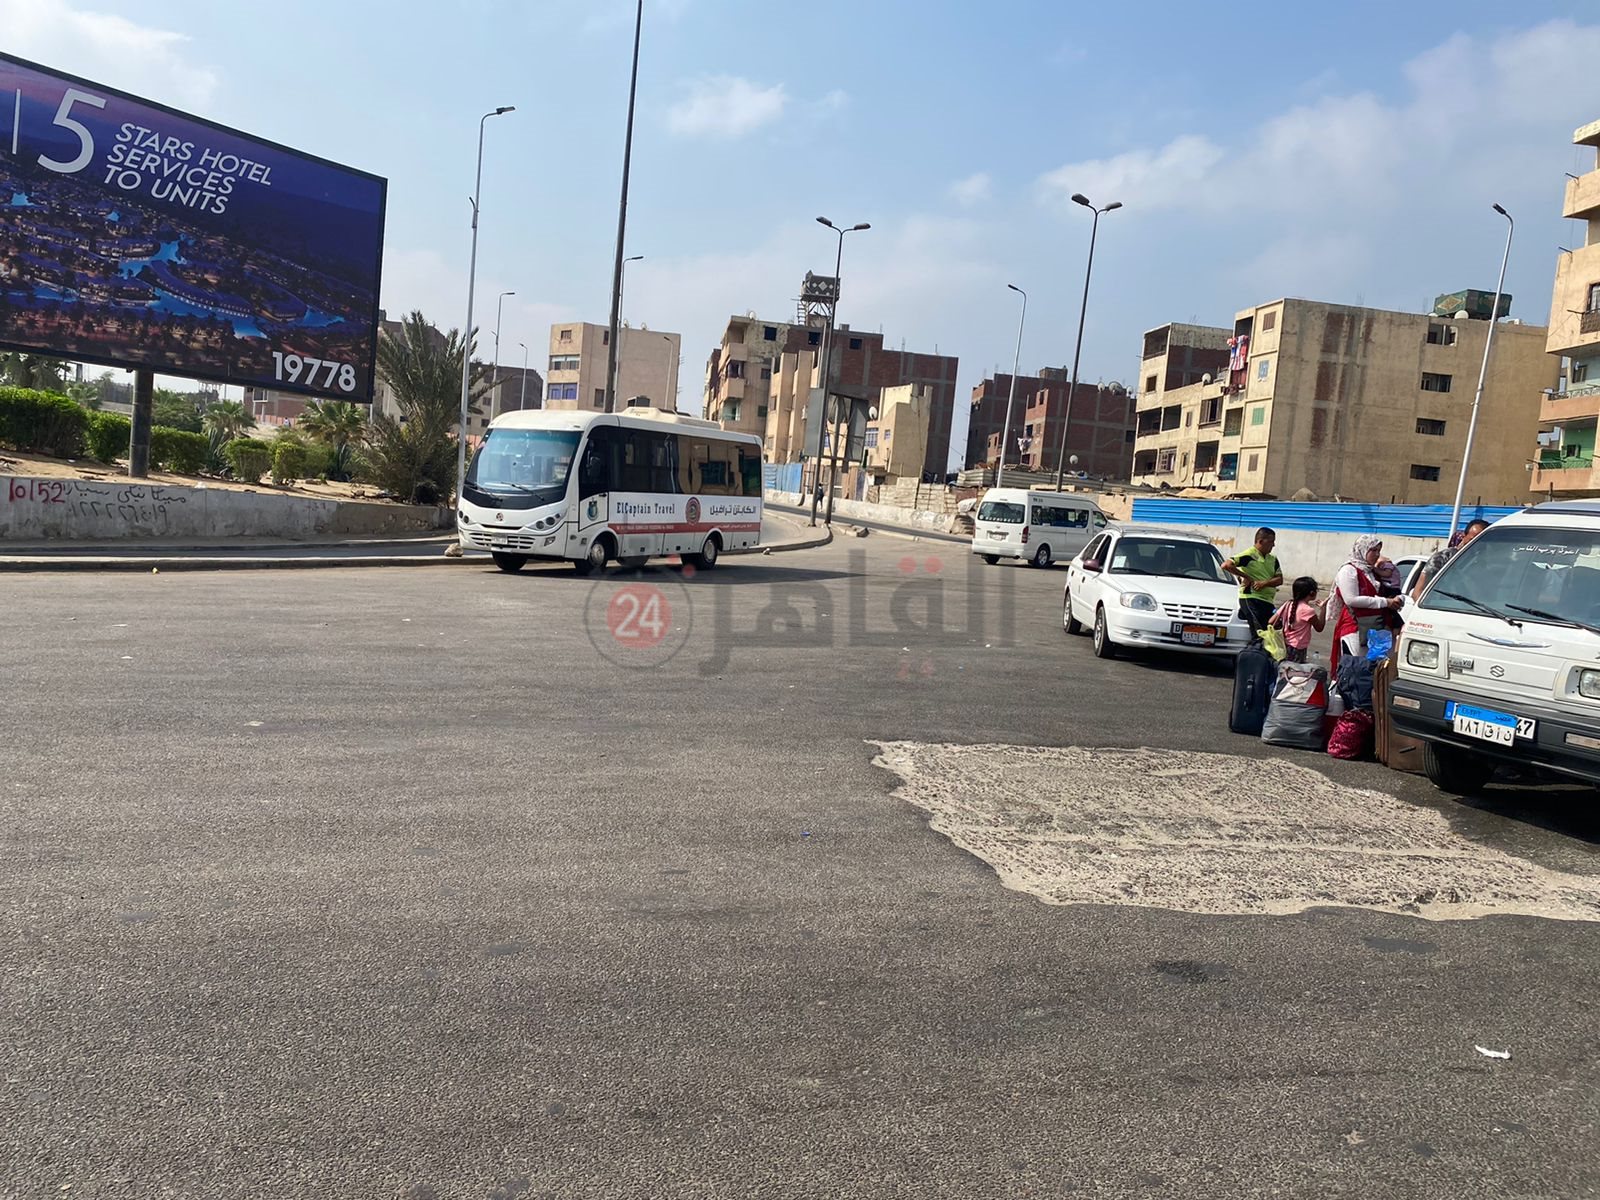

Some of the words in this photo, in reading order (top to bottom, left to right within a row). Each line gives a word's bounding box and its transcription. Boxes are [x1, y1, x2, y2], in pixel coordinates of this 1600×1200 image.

[37, 88, 107, 173] 5
[116, 122, 195, 161] STARS
[199, 148, 272, 186] HOTEL
[104, 164, 142, 190] TO
[150, 178, 229, 214] UNITS
[107, 144, 236, 194] SERVICES
[272, 351, 356, 392] 19778
[654, 503, 675, 514] Travel
